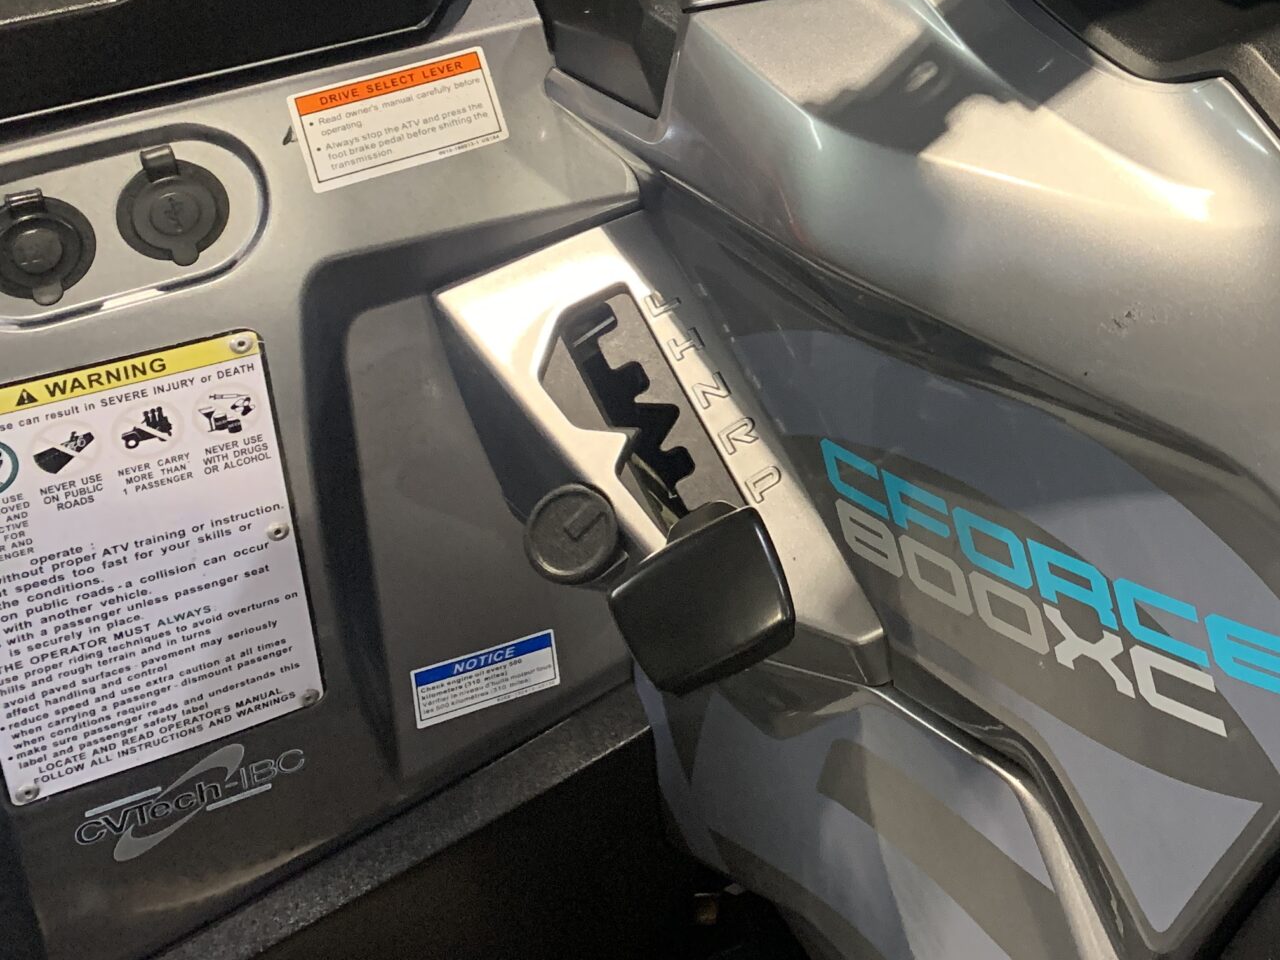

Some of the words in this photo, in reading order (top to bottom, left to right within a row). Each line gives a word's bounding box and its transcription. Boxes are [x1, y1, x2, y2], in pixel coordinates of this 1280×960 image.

[318, 113, 342, 125] Read
[346, 104, 378, 119] owner's
[382, 95, 414, 109] manual
[416, 84, 451, 102] carefully
[454, 76, 480, 90] before
[320, 88, 359, 106] DRIVE
[367, 74, 415, 93] SELECT
[423, 61, 463, 78] LEVER
[321, 120, 363, 137] operating
[326, 135, 359, 151] Always
[362, 130, 382, 144] stop
[402, 119, 420, 131] ATV
[441, 107, 467, 122] press
[328, 149, 347, 160] foot
[349, 142, 376, 156] brake
[379, 133, 404, 149] pedal
[408, 126, 436, 140] before
[439, 117, 472, 133] shifting
[331, 149, 392, 170] transmission
[644, 294, 682, 318] L
[668, 327, 706, 361] H
[19, 416, 39, 427] can
[45, 406, 80, 420] result
[100, 389, 149, 407] SEVERE
[153, 377, 194, 394] INJURY
[217, 363, 255, 379] DEATH
[45, 358, 167, 398] WARNING
[692, 371, 732, 410] N
[203, 454, 229, 466] WITH
[233, 443, 269, 459] DRUGS
[205, 440, 239, 455] NEVER
[243, 434, 264, 446] USE
[718, 417, 759, 456] R
[118, 462, 150, 477] NEVER
[157, 453, 190, 467] CARRY
[126, 472, 154, 485] MORE
[161, 463, 187, 475] THAN
[135, 472, 194, 492] PASSENGER
[204, 466, 219, 475] OR
[223, 453, 272, 470] ALCOHOL
[2, 493, 24, 504] USE
[40, 480, 76, 496] NEVER
[80, 473, 103, 485] USE
[43, 495, 59, 505] ON
[65, 483, 103, 500] PUBLIC
[57, 495, 95, 511] ROADS
[745, 466, 782, 504] P
[4, 531, 25, 541] FOR
[6, 511, 28, 522] AND
[11, 538, 33, 549] AND
[30, 546, 83, 565] operate
[52, 553, 96, 573] proper
[102, 542, 129, 557] ATV
[134, 528, 186, 548] training
[210, 503, 284, 528] instruction.
[15, 574, 65, 593] speeds
[102, 556, 128, 569] fast
[135, 550, 153, 561] for
[161, 540, 191, 556] your
[197, 529, 231, 544] skills
[26, 597, 69, 617] public
[76, 586, 114, 602] roads
[140, 562, 197, 584] collision
[203, 554, 226, 566] can
[234, 542, 270, 558] occur
[7, 632, 34, 646] with
[54, 608, 121, 634] passenger
[127, 595, 169, 612] unless
[174, 574, 238, 600] passenger
[244, 565, 270, 578] seat
[27, 577, 104, 602] conditions.
[3, 620, 32, 634] with
[40, 603, 92, 624] another
[100, 589, 152, 607] vehicle.
[836, 498, 1228, 737] 800XC
[24, 662, 63, 679] proper
[69, 650, 104, 665] riding
[108, 631, 172, 653] techniques
[192, 614, 222, 629] avoid
[228, 597, 280, 618] overturns
[27, 630, 82, 652] securely
[106, 614, 144, 631] place.
[30, 637, 106, 665] OPERATOR
[114, 623, 150, 641] MUST
[157, 605, 211, 627] ALWAYS
[1, 685, 26, 696] hills
[58, 664, 92, 679] rough
[97, 651, 136, 668] terrain
[182, 628, 211, 642] turns
[3, 693, 36, 709] avoid
[41, 680, 76, 698] paved
[81, 665, 131, 685] surfaces
[141, 644, 195, 667] pavement
[200, 637, 223, 650] may
[228, 619, 278, 640] seriously
[453, 646, 516, 675] NOTICE
[6, 703, 40, 719] affect
[45, 686, 96, 707] handling
[127, 663, 168, 682] control
[8, 712, 49, 730] reduce
[54, 699, 89, 716] speed
[121, 684, 141, 695] use
[145, 673, 174, 687] extra
[179, 658, 220, 677] caution
[257, 639, 286, 652] times
[11, 725, 42, 740] when
[48, 708, 96, 729] carrying
[113, 684, 170, 709] passenger
[181, 665, 233, 687] dismount
[237, 646, 293, 670] passenger
[13, 735, 45, 750] when
[50, 714, 112, 738] conditions
[117, 700, 157, 718] require
[16, 744, 47, 760] make
[53, 736, 78, 747] sure
[83, 714, 142, 738] passenger
[148, 702, 178, 717] reads
[184, 695, 204, 706] and
[208, 671, 276, 697] understands
[280, 662, 300, 673] this
[38, 754, 87, 774] LOCATE
[92, 743, 117, 756] AND
[122, 731, 154, 747] READ
[159, 702, 231, 734] OPERATOR'S
[236, 688, 282, 709] MANUAL
[19, 755, 47, 769] label
[53, 747, 74, 758] and
[79, 725, 138, 750] passenger
[143, 713, 177, 729] safety
[182, 703, 209, 717] label
[34, 764, 85, 785] FOLLOW
[90, 755, 112, 768] ALL
[117, 725, 204, 758] INSTRUCTIONS
[208, 715, 232, 728] AND
[237, 692, 296, 718] WARNINGS
[75, 749, 305, 845] CVTech-IBC
